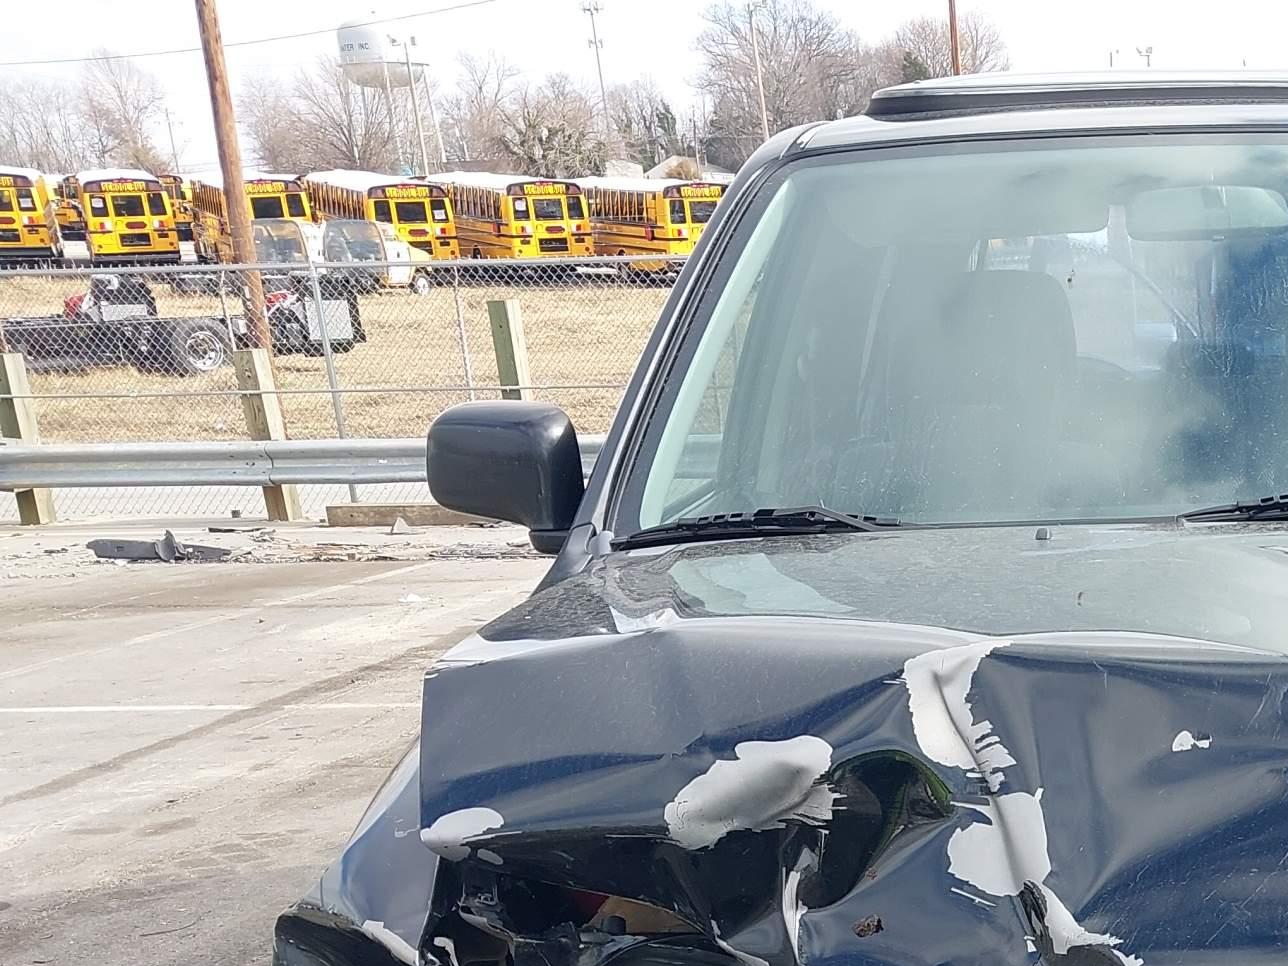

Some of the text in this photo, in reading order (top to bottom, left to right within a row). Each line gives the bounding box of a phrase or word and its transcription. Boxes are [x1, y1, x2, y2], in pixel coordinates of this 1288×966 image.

[102, 182, 145, 191] SCHOOL BUS
[525, 184, 566, 195] SCHOOL BUS
[386, 187, 429, 198] SCHOOL BUS
[682, 187, 721, 197] SCHOOL BUS
